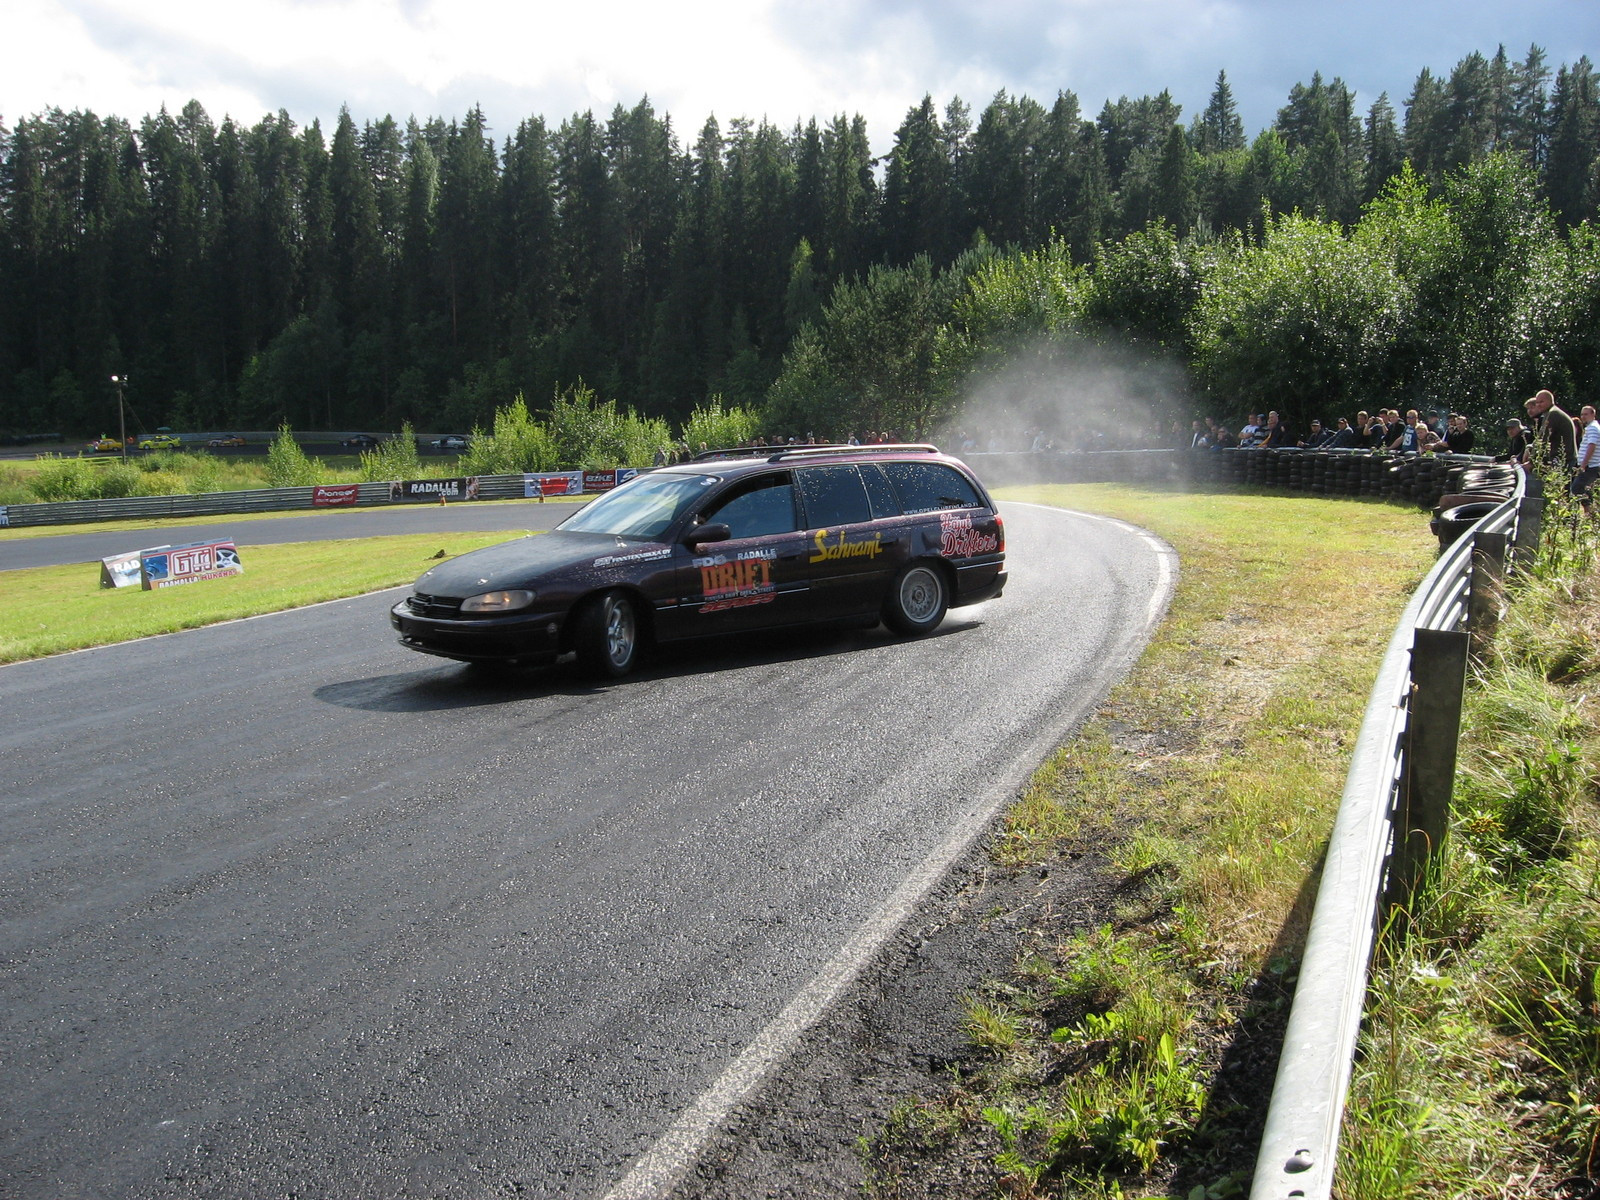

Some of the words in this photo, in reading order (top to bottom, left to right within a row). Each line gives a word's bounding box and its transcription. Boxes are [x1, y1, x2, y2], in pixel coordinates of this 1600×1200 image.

[317, 489, 355, 497] Pioneer
[411, 481, 458, 494] RADALLE
[438, 489, 459, 497] .com
[810, 530, 882, 563] Sahrami
[941, 529, 997, 558] Drifters
[737, 548, 776, 560] RADALLE
[113, 560, 141, 573] RAD
[701, 558, 772, 597] DRIFT
[698, 592, 777, 614] SERIES
